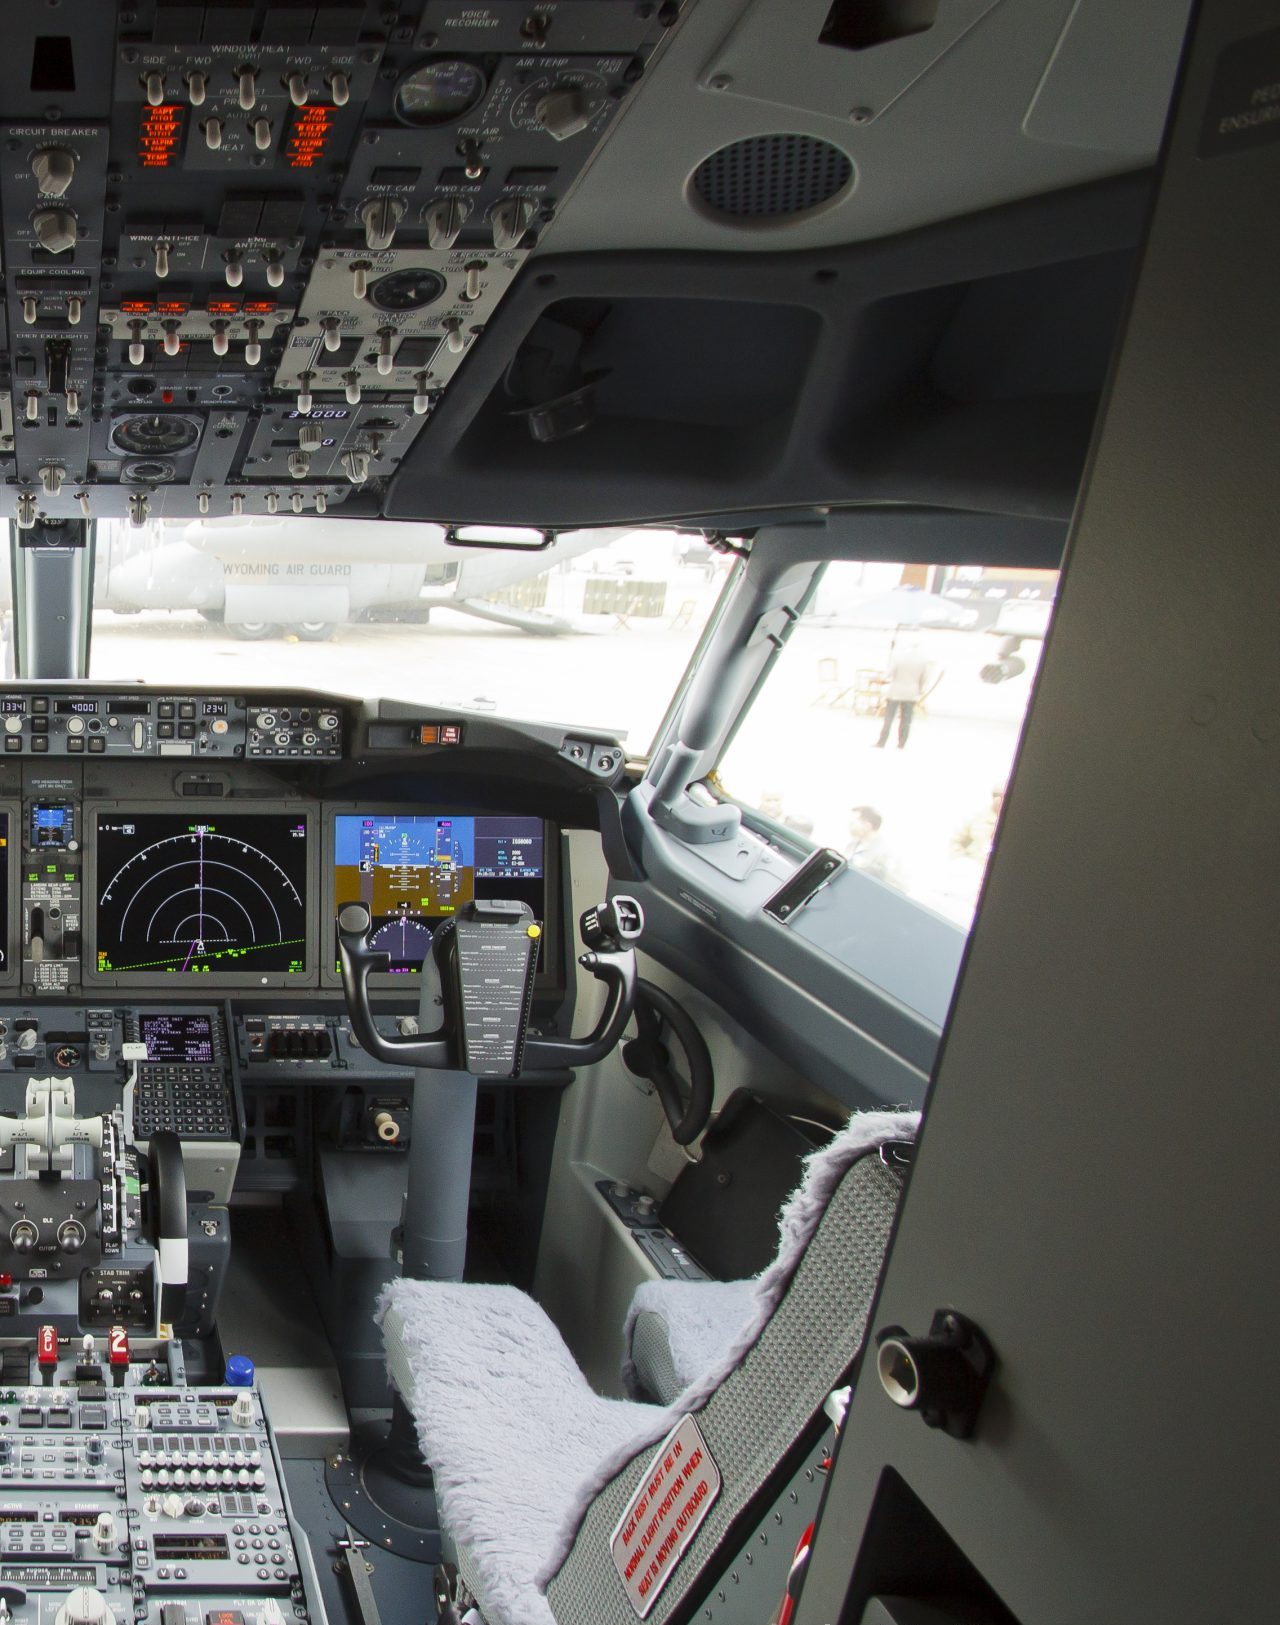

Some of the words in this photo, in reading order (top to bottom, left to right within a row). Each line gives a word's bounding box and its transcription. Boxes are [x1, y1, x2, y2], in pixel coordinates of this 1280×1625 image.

[211, 45, 256, 53] WINDOW
[496, 88, 511, 117] DUCT
[223, 563, 279, 575] WYOMING
[286, 564, 304, 575] AIR
[310, 564, 351, 576] GUARD
[44, 1331, 53, 1351] APU
[112, 1331, 126, 1352] 2
[622, 1517, 638, 1546] BACK
[634, 1492, 649, 1522] REST
[648, 1469, 664, 1499] MUST
[663, 1452, 675, 1475] BE
[673, 1440, 683, 1458] IN
[624, 1545, 645, 1582] NORMAL
[641, 1512, 660, 1551] FLIGHT
[657, 1475, 685, 1522] POSITION
[682, 1447, 703, 1481] WHEN
[638, 1568, 653, 1598] SEAT
[650, 1559, 659, 1576] IS
[655, 1528, 679, 1569] MOVING
[676, 1479, 708, 1532] OUTBOARD
